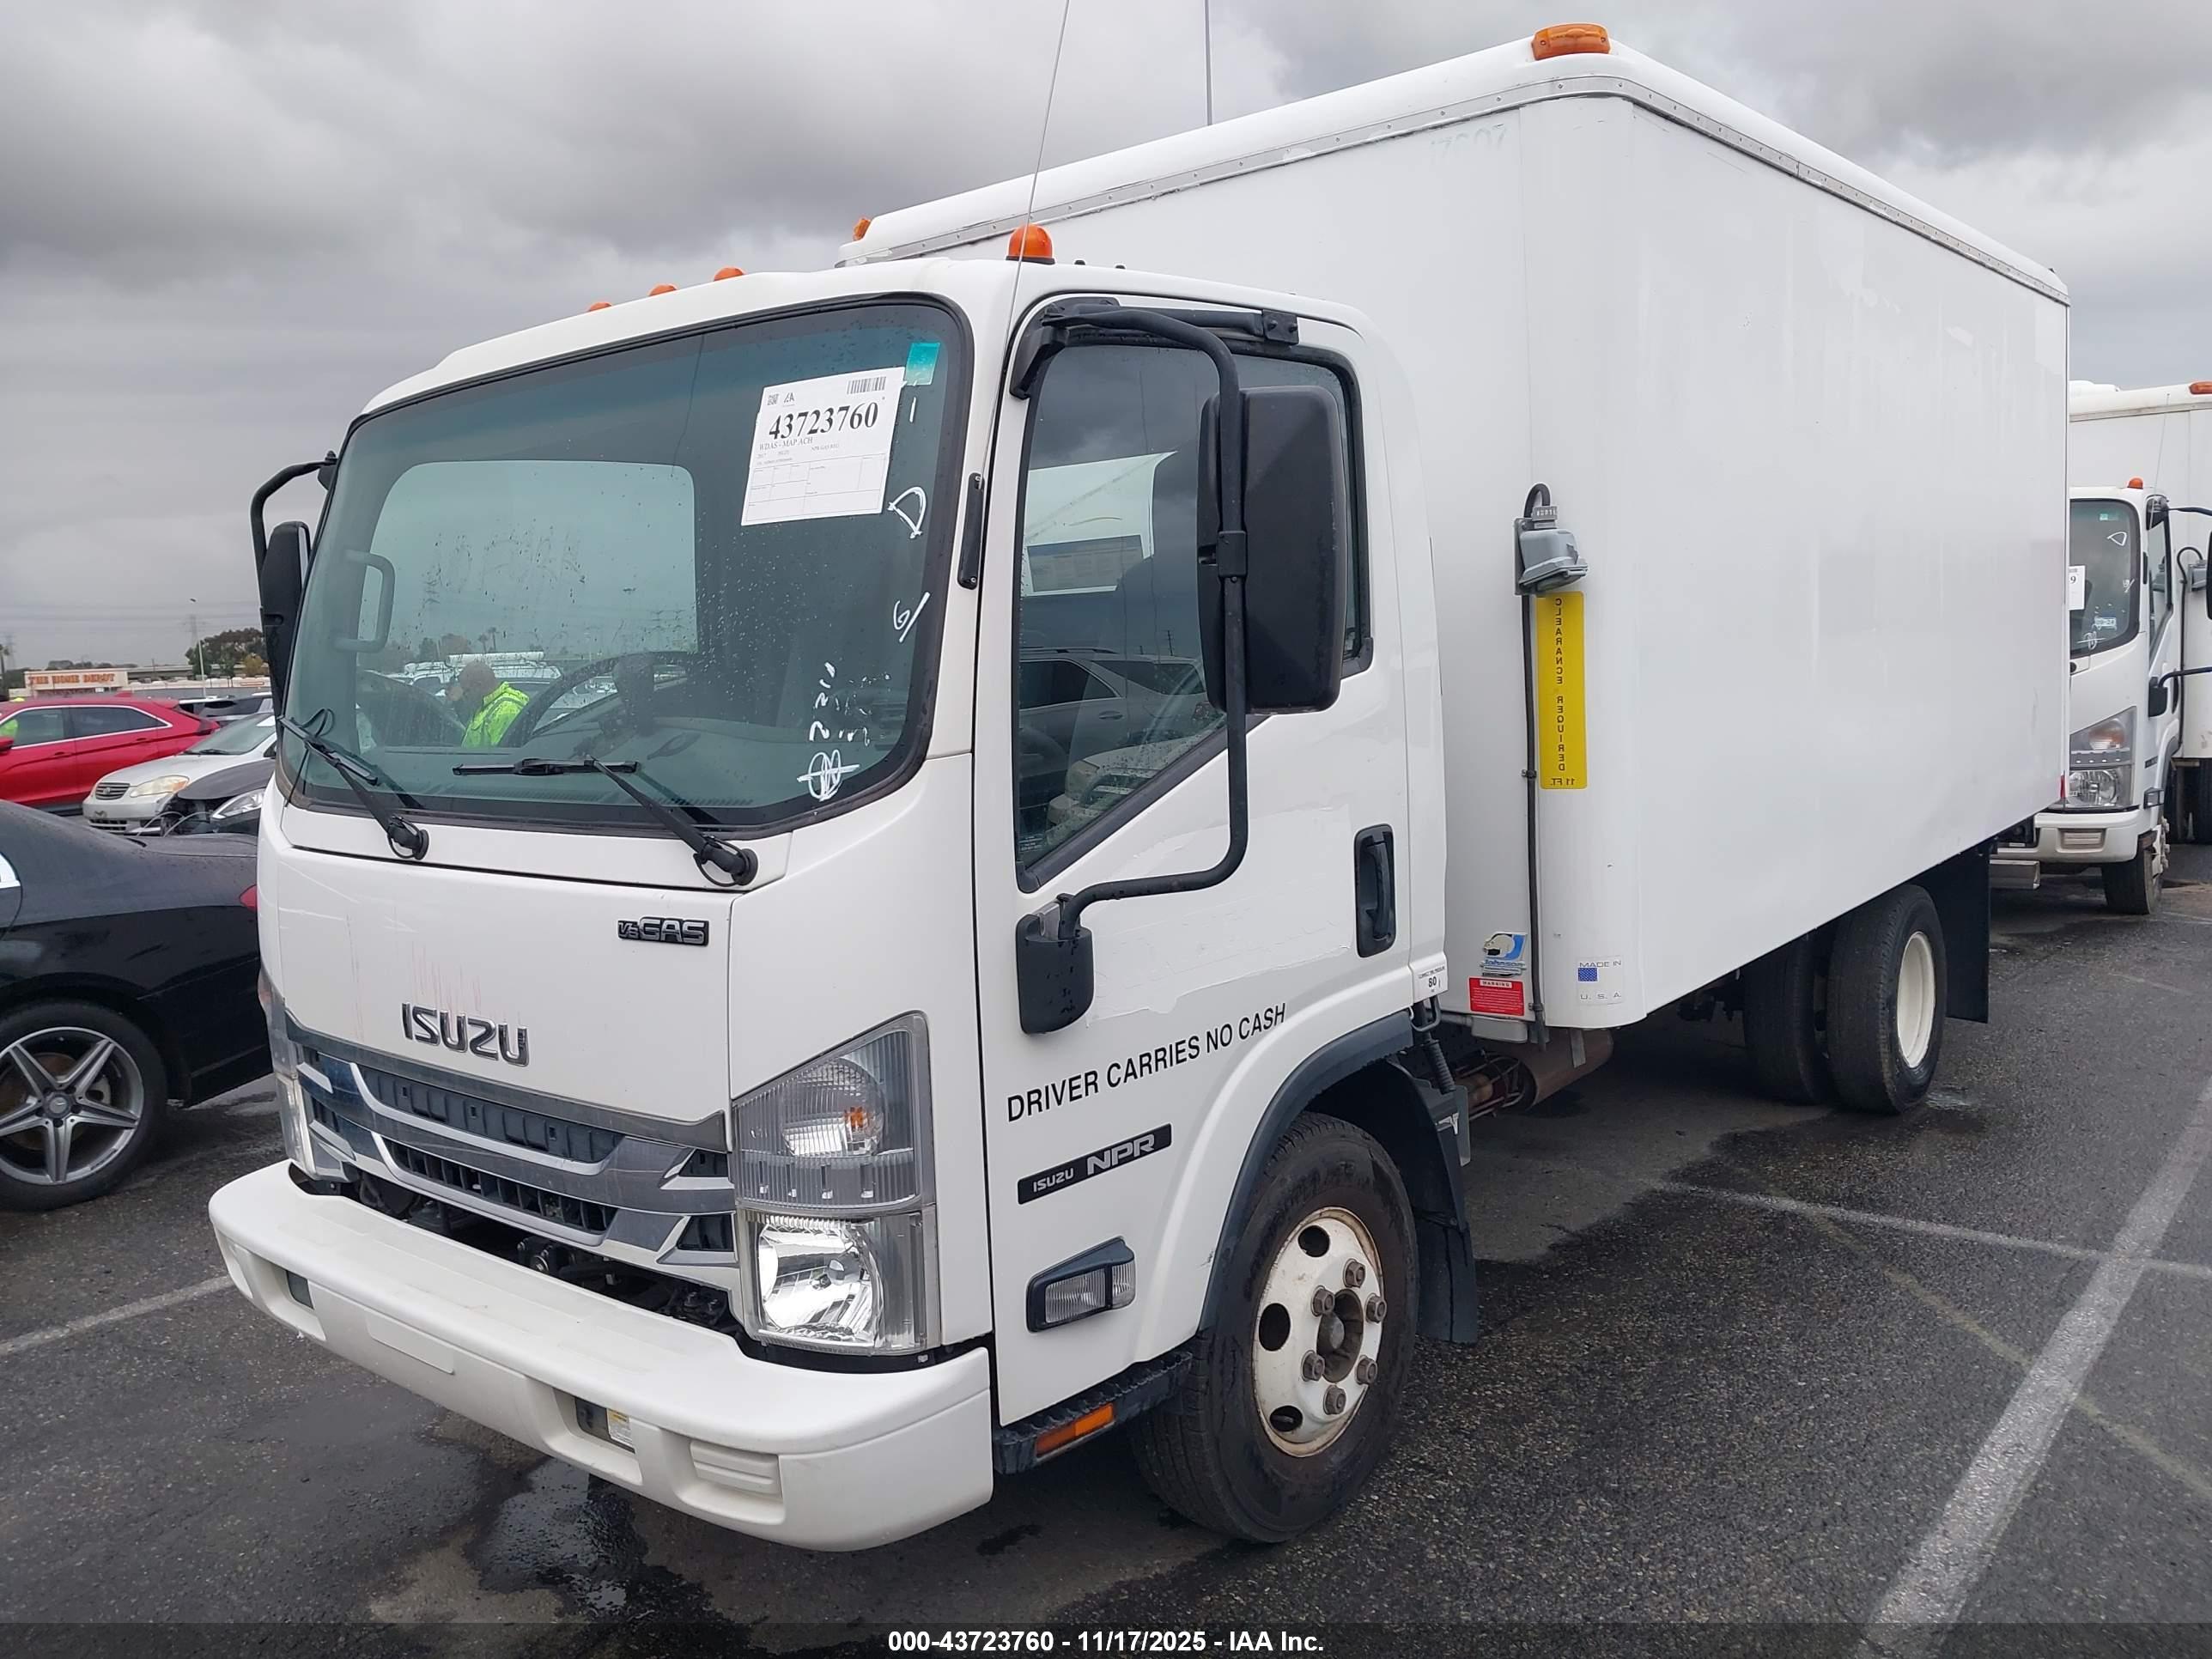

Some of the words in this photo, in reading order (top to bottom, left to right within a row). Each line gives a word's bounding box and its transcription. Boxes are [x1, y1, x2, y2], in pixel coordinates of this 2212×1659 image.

[769, 401, 879, 441] 43723760
[402, 1001, 530, 1066] ISUZU
[1006, 1070, 1099, 1122] DRIVER
[1107, 1036, 1200, 1088] CARRIES
[1206, 1024, 1233, 1053] NO
[1238, 1003, 1286, 1040] CASH
[1033, 1168, 1074, 1193] ISUZU
[1086, 1133, 1155, 1176] NPR
